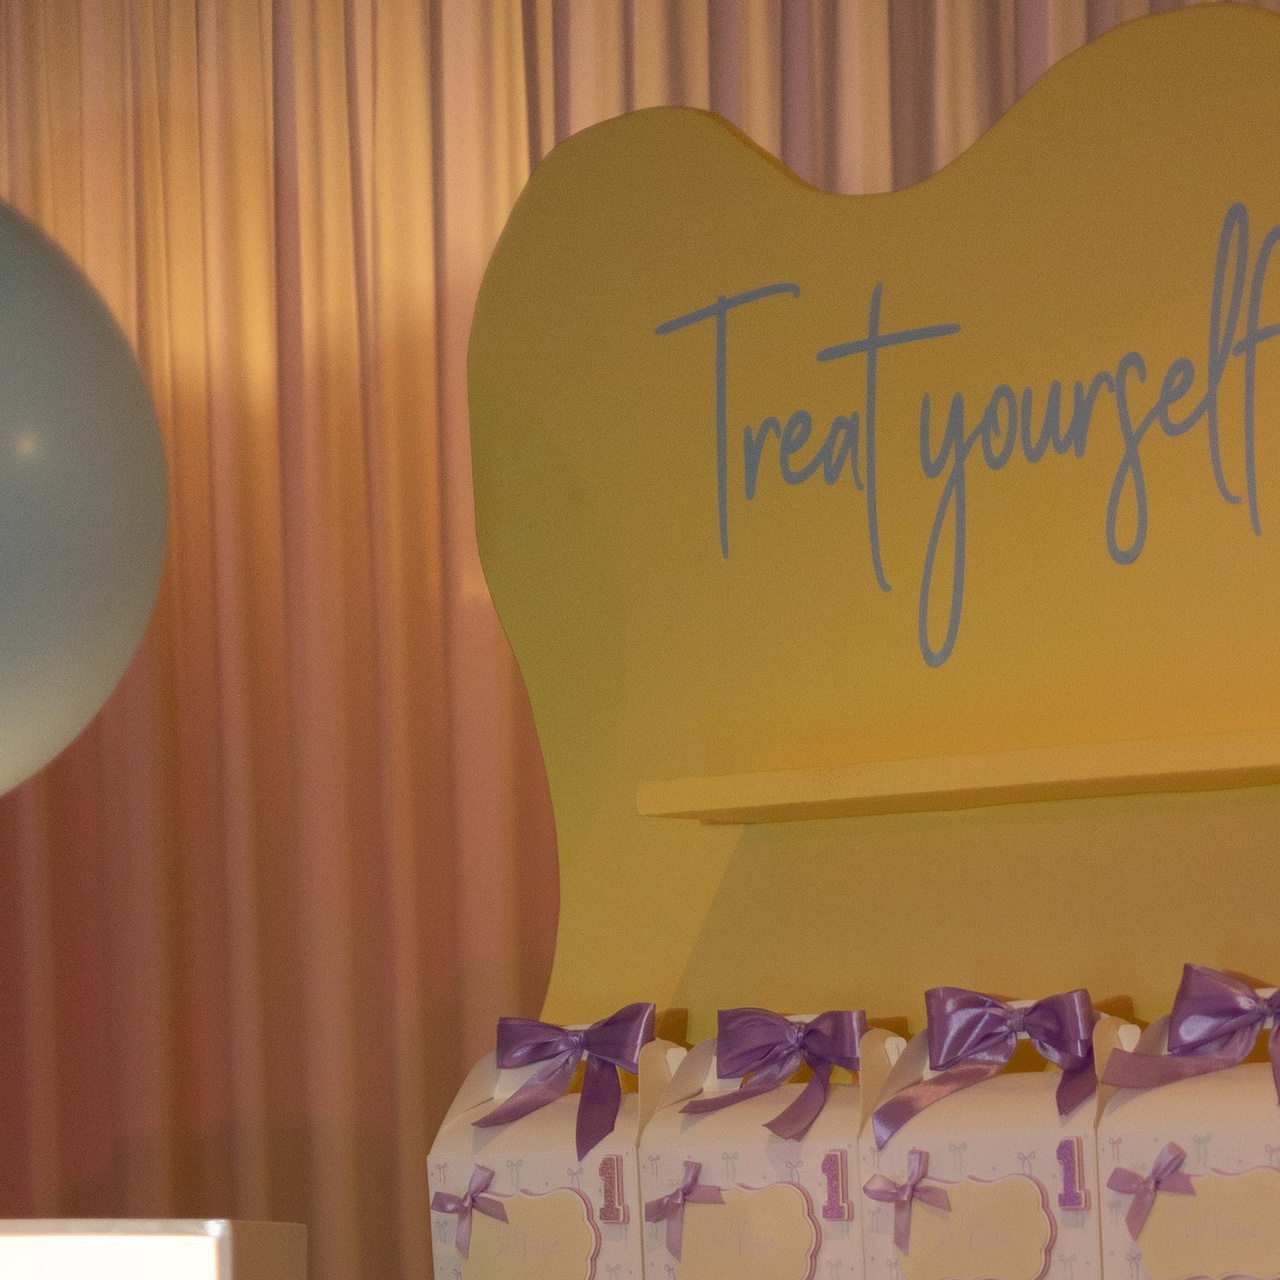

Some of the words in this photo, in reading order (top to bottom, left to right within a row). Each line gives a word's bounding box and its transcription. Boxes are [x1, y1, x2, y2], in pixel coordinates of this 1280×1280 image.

[654, 281, 961, 593] Treat
[599, 1153, 629, 1224] 1
[821, 1149, 854, 1222] 1
[1058, 1136, 1091, 1211] 1
